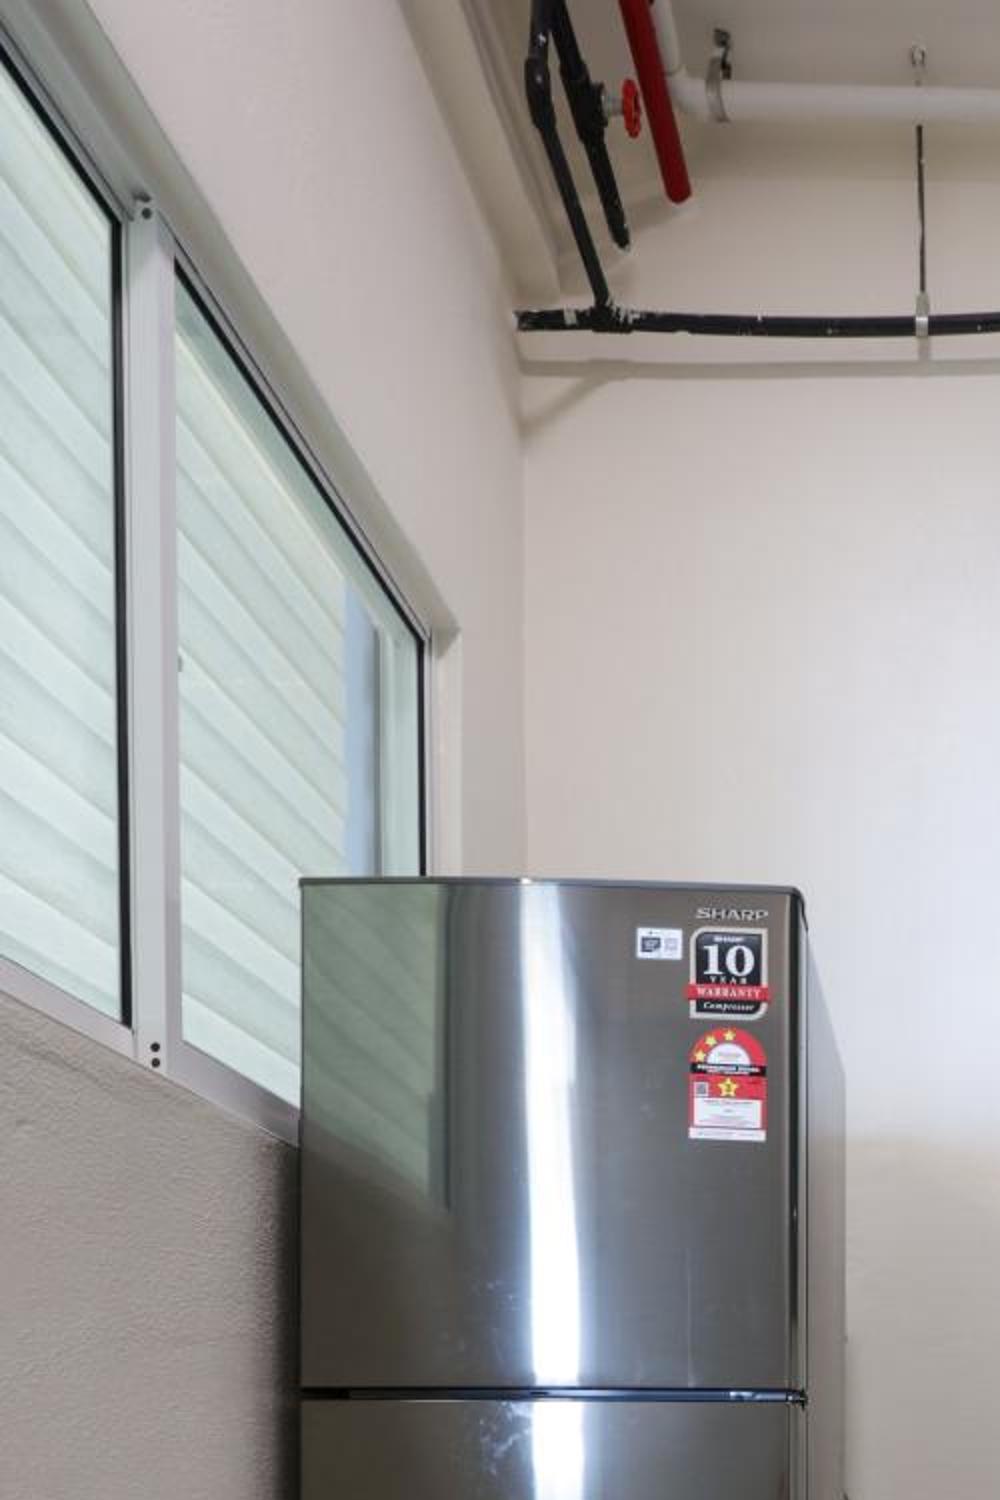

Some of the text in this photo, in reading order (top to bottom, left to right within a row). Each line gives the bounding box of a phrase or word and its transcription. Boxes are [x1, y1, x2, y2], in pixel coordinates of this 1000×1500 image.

[696, 907, 768, 921] SHARP
[703, 944, 755, 977] 10
[709, 976, 748, 985] YEAR
[696, 986, 762, 999] WARRANTY
[703, 1001, 756, 1012] Compressor
